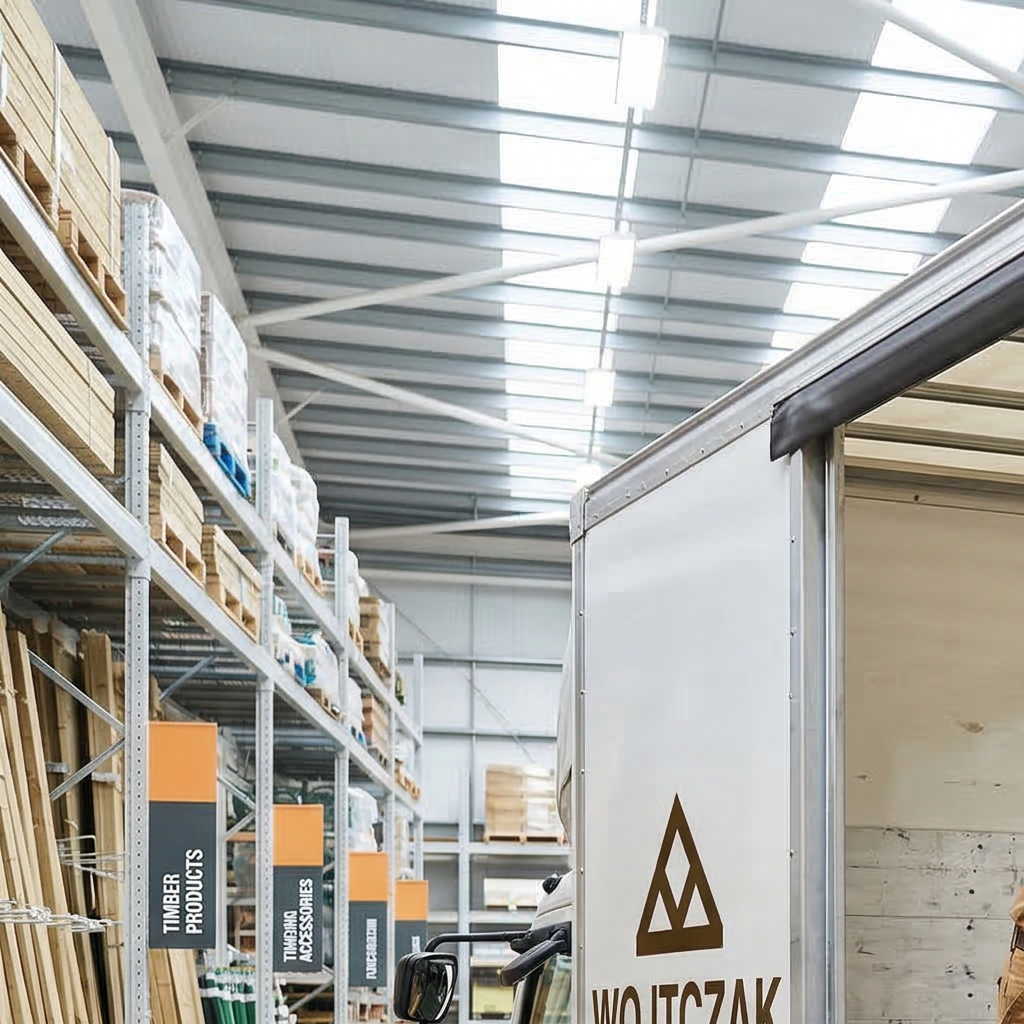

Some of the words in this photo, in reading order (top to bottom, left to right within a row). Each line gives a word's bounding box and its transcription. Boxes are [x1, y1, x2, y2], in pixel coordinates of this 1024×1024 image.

[163, 873, 180, 935] TIMBER
[185, 849, 204, 935] PRODUCTS
[298, 878, 313, 963] ACCESSORIES
